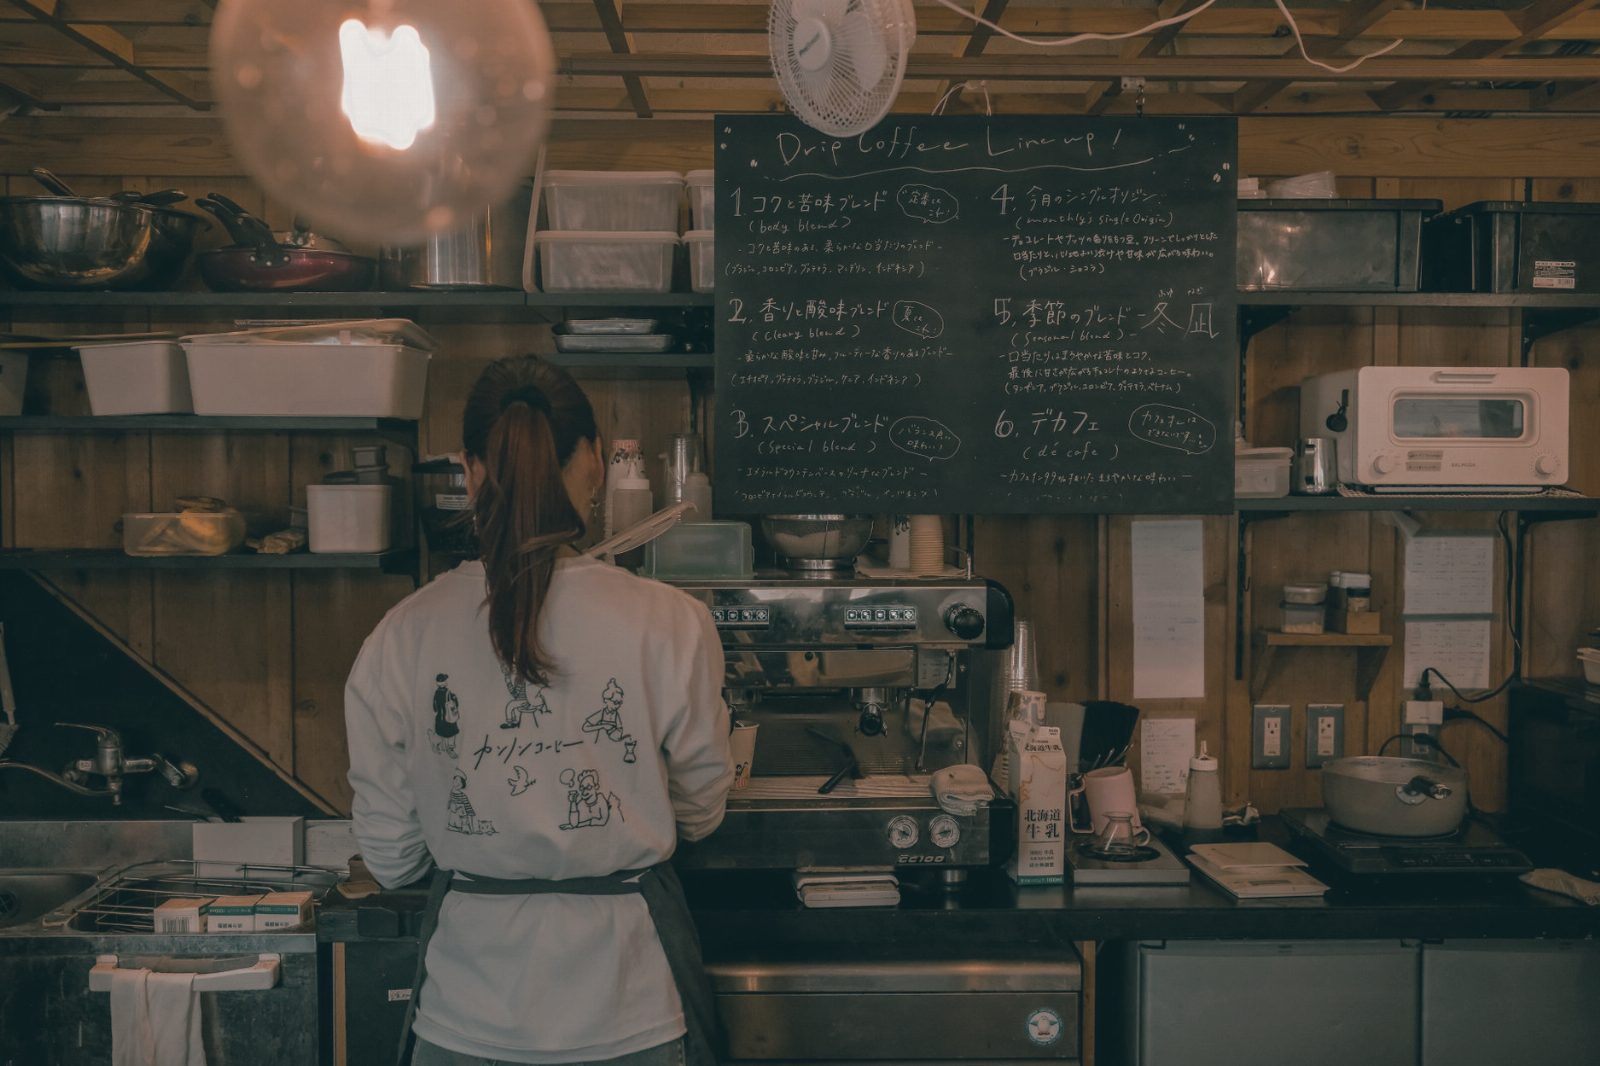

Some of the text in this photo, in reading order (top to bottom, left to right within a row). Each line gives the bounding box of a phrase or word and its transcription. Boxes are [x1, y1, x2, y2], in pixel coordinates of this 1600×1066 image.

[776, 132, 841, 166] Drip
[858, 126, 969, 158] Coffee
[985, 124, 1056, 156] Line
[752, 190, 888, 214] コクと苦味ブレンド
[760, 297, 890, 322] 香りと酸味ブレンド
[1022, 299, 1133, 328] 季節のブレンド
[762, 412, 888, 434] スペシャルブレンド
[1032, 408, 1100, 436] デカフェ
[1025, 809, 1062, 822] 北海道
[1026, 823, 1060, 839] 牛乳
